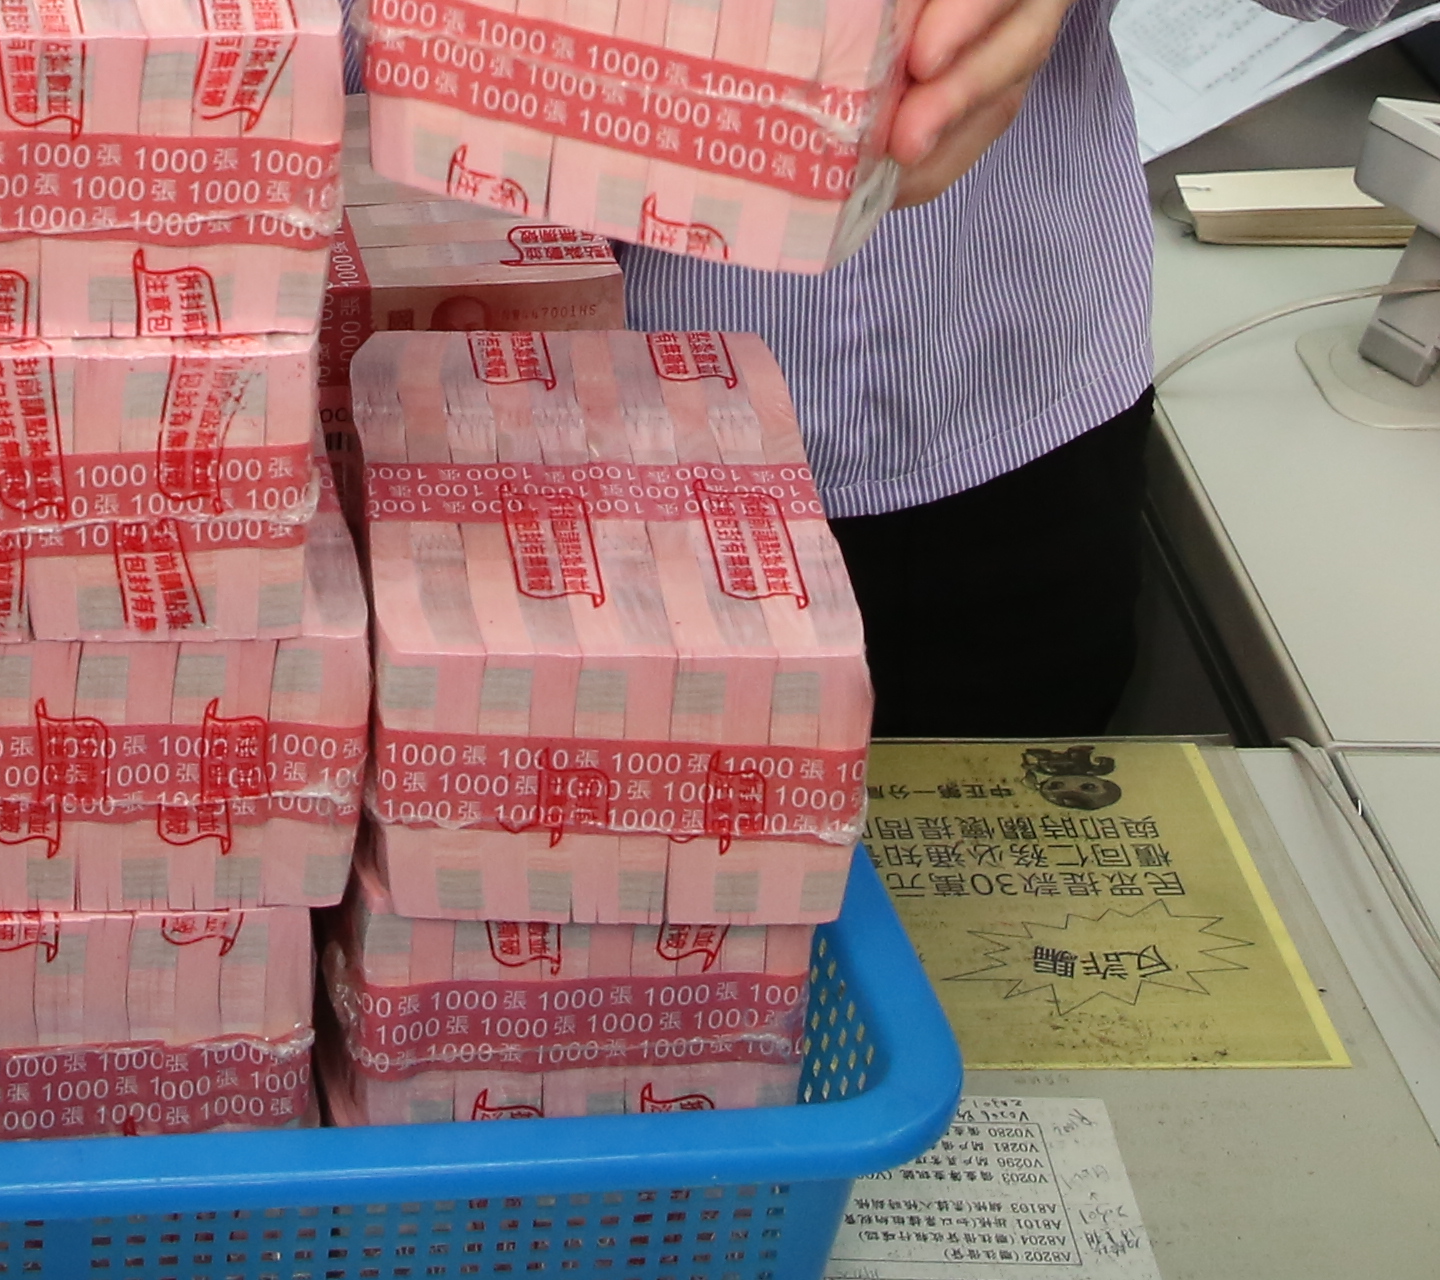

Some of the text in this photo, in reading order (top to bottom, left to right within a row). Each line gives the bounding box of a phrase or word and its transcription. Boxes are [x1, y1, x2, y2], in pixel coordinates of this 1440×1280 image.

[442, 8, 466, 33] 張
[476, 19, 546, 55] 1000
[551, 34, 576, 59] 張
[587, 44, 661, 82] 1000
[666, 60, 690, 86] 張
[365, 57, 797, 179] 1000 張 1000 張 1000 張 1000 張
[36, 175, 59, 197] 張
[72, 176, 145, 202] 1000
[152, 180, 176, 203] 張
[190, 179, 260, 205] 1000
[267, 180, 291, 202] 張
[386, 743, 487, 768] 1000 張
[612, 752, 681, 775] 1000
[885, 871, 1185, 897] 民眾提款30萬元
[1032, 944, 1171, 980] 反詐騙
[397, 981, 738, 1018] 張 1000 張 1000 張 1000 張
[7, 1082, 30, 1104] 張
[42, 1078, 109, 1102] 1000
[115, 1075, 139, 1097] 張
[987, 1127, 1034, 1138] V0280
[993, 1142, 1039, 1153] V0281
[997, 1157, 1044, 1168] V0296
[1001, 1172, 1048, 1184] V0203
[1010, 1203, 1057, 1214] A8103
[1016, 1218, 1061, 1230] A8101
[1021, 1235, 1066, 1245] A8204
[1024, 1251, 1071, 1262] A8202
